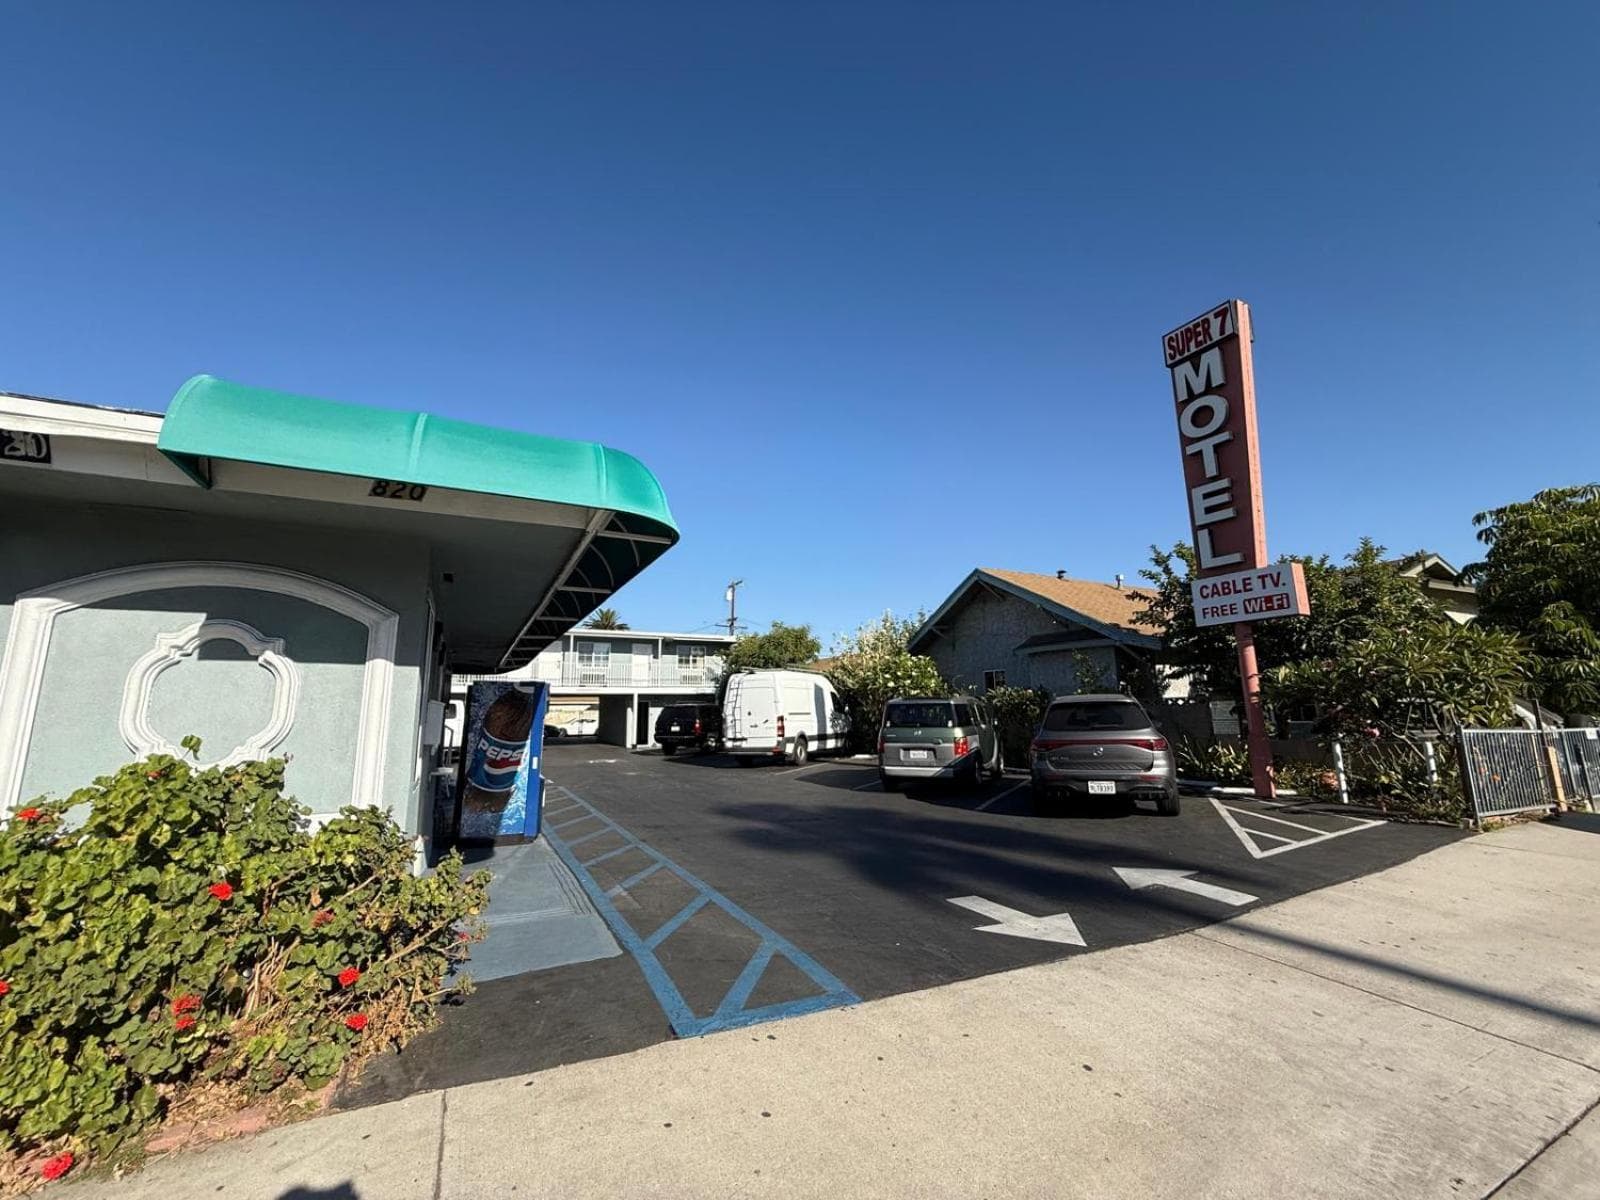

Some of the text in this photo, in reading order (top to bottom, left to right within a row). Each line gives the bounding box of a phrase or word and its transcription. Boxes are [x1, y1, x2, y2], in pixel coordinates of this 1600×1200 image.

[1167, 306, 1229, 361] SUPER 7
[1173, 346, 1244, 570] MOTEL
[371, 480, 428, 501] 820
[1200, 577, 1253, 600] CABLE
[1202, 603, 1238, 619] FREE
[477, 737, 527, 761] PEPS
